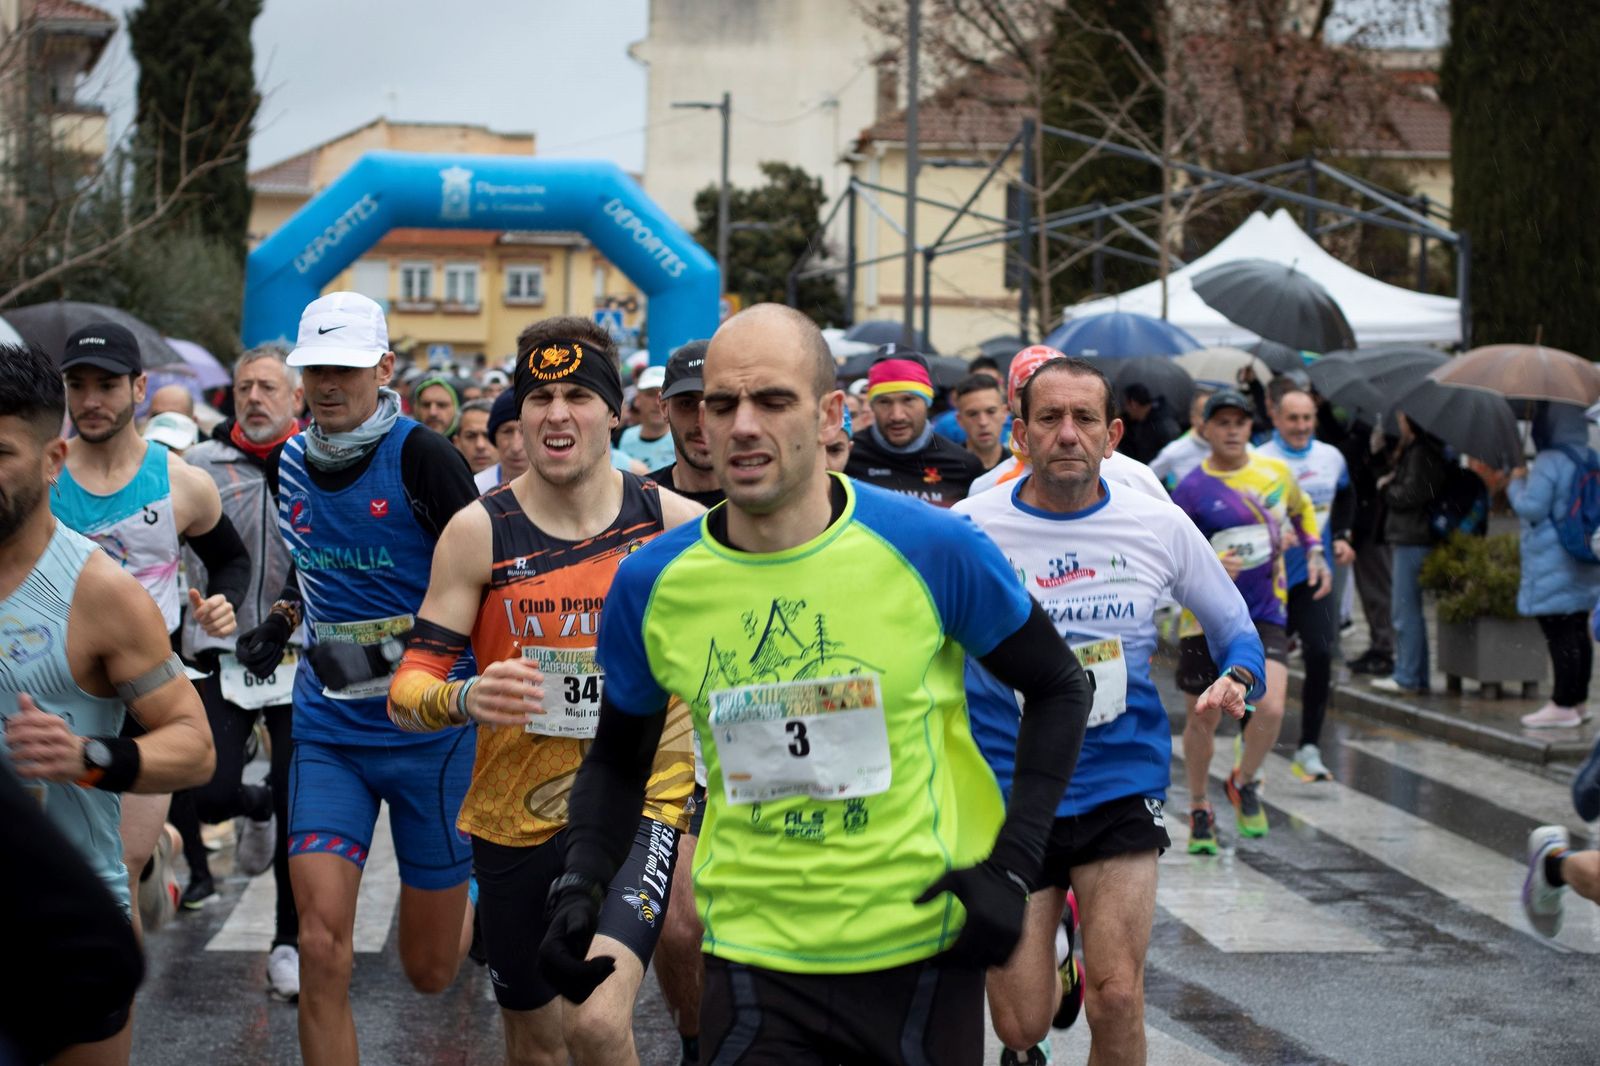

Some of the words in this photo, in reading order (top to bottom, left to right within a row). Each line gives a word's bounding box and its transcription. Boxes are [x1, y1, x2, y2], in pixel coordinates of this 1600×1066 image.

[294, 194, 378, 274] DEPORTES
[603, 199, 688, 277] DEPORTES
[1049, 552, 1079, 579] 35
[503, 599, 545, 637] LA
[559, 612, 600, 637] ZU
[519, 598, 555, 614] Club
[561, 597, 604, 614] Depo
[1045, 601, 1135, 622] RACENA
[538, 662, 578, 674] CADEROS
[563, 676, 605, 704] 34
[565, 708, 586, 718] Misil
[785, 721, 810, 757] 3
[645, 854, 658, 876] Club
